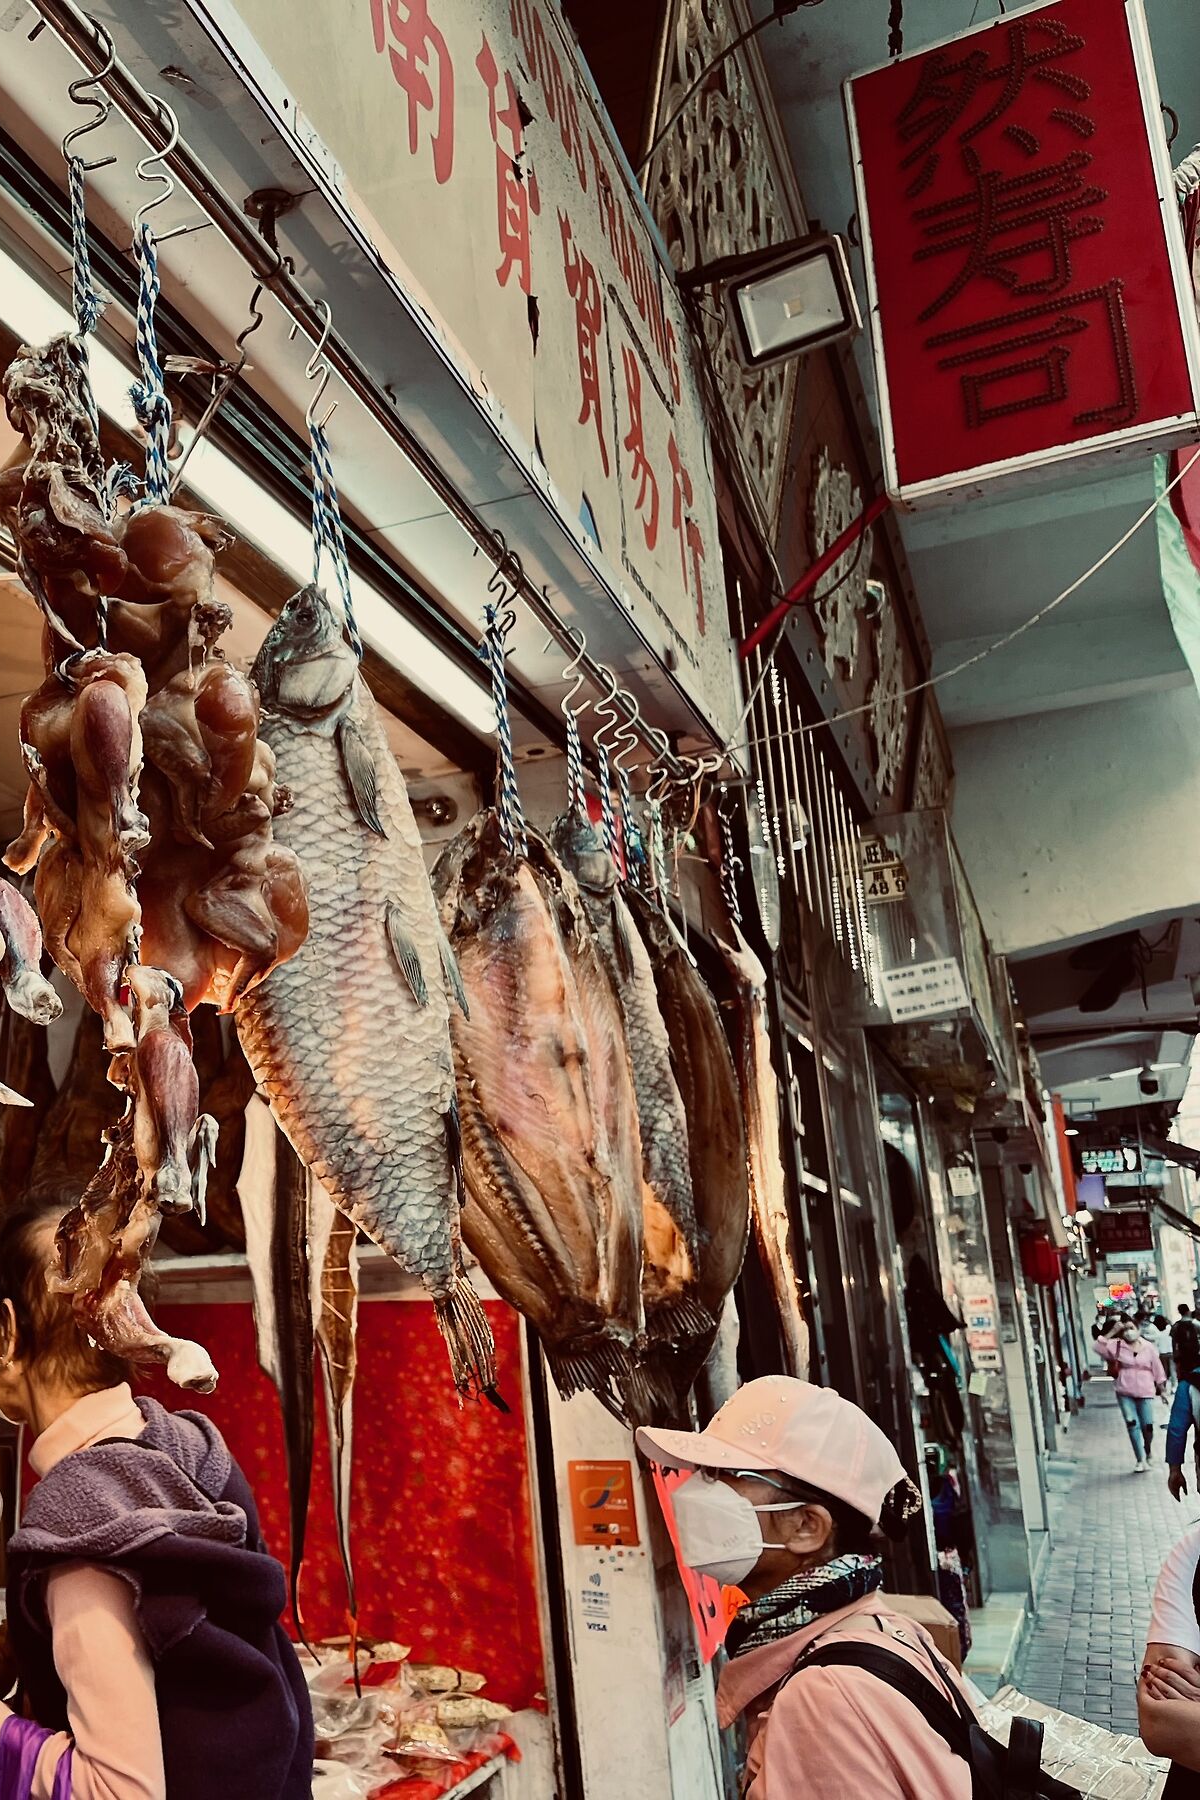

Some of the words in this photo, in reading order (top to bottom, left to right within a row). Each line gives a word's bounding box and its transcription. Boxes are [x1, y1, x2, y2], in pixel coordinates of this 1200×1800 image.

[897, 17, 1140, 431] 然寿司
[586, 1622, 608, 1632] VISA
